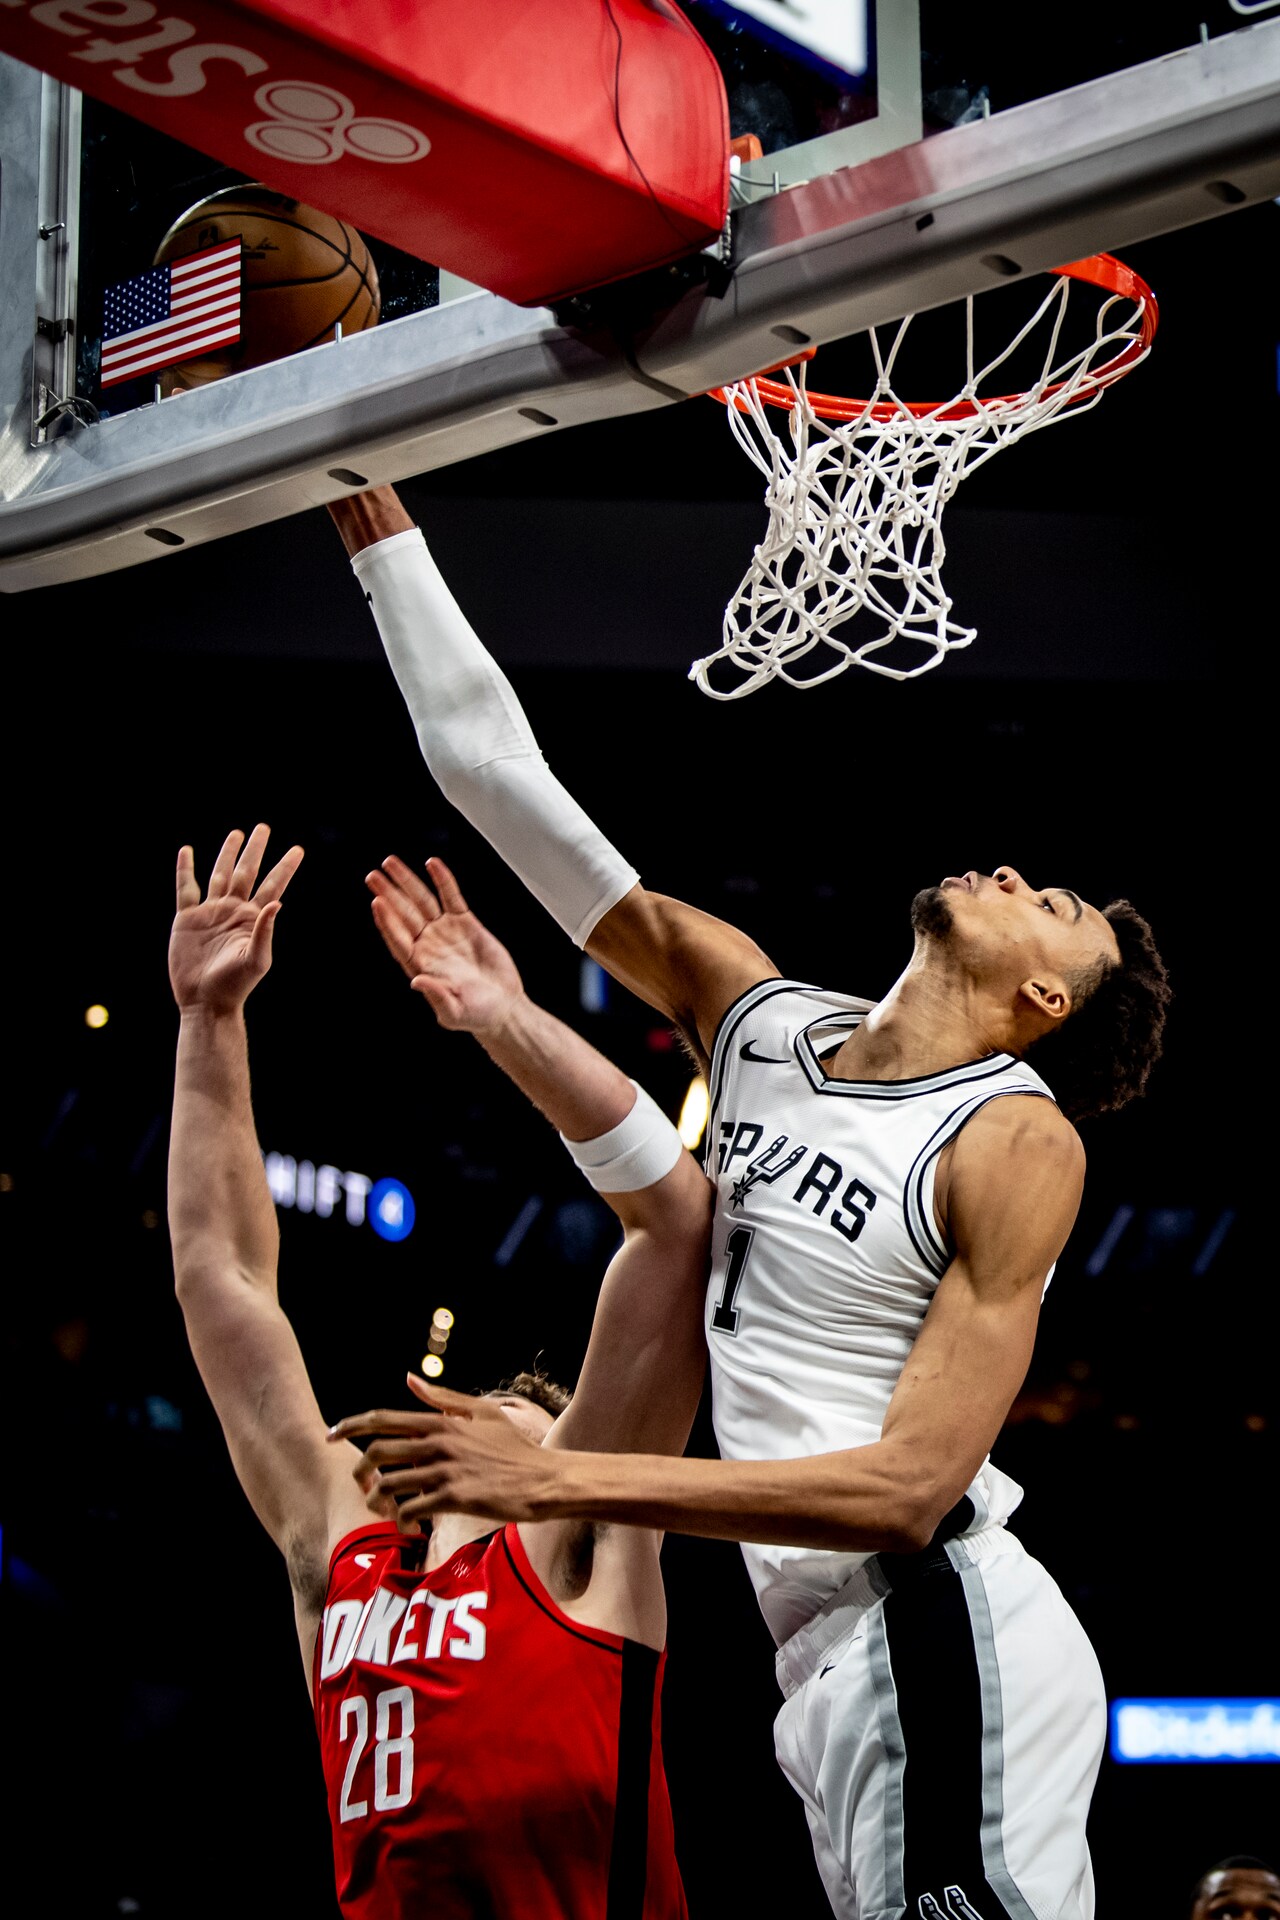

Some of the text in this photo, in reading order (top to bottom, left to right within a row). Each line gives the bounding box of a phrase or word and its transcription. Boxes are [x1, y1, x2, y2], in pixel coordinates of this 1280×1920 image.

[0, 0, 269, 97] Sta
[710, 1224, 756, 1338] 1
[339, 1685, 415, 1824] 28
